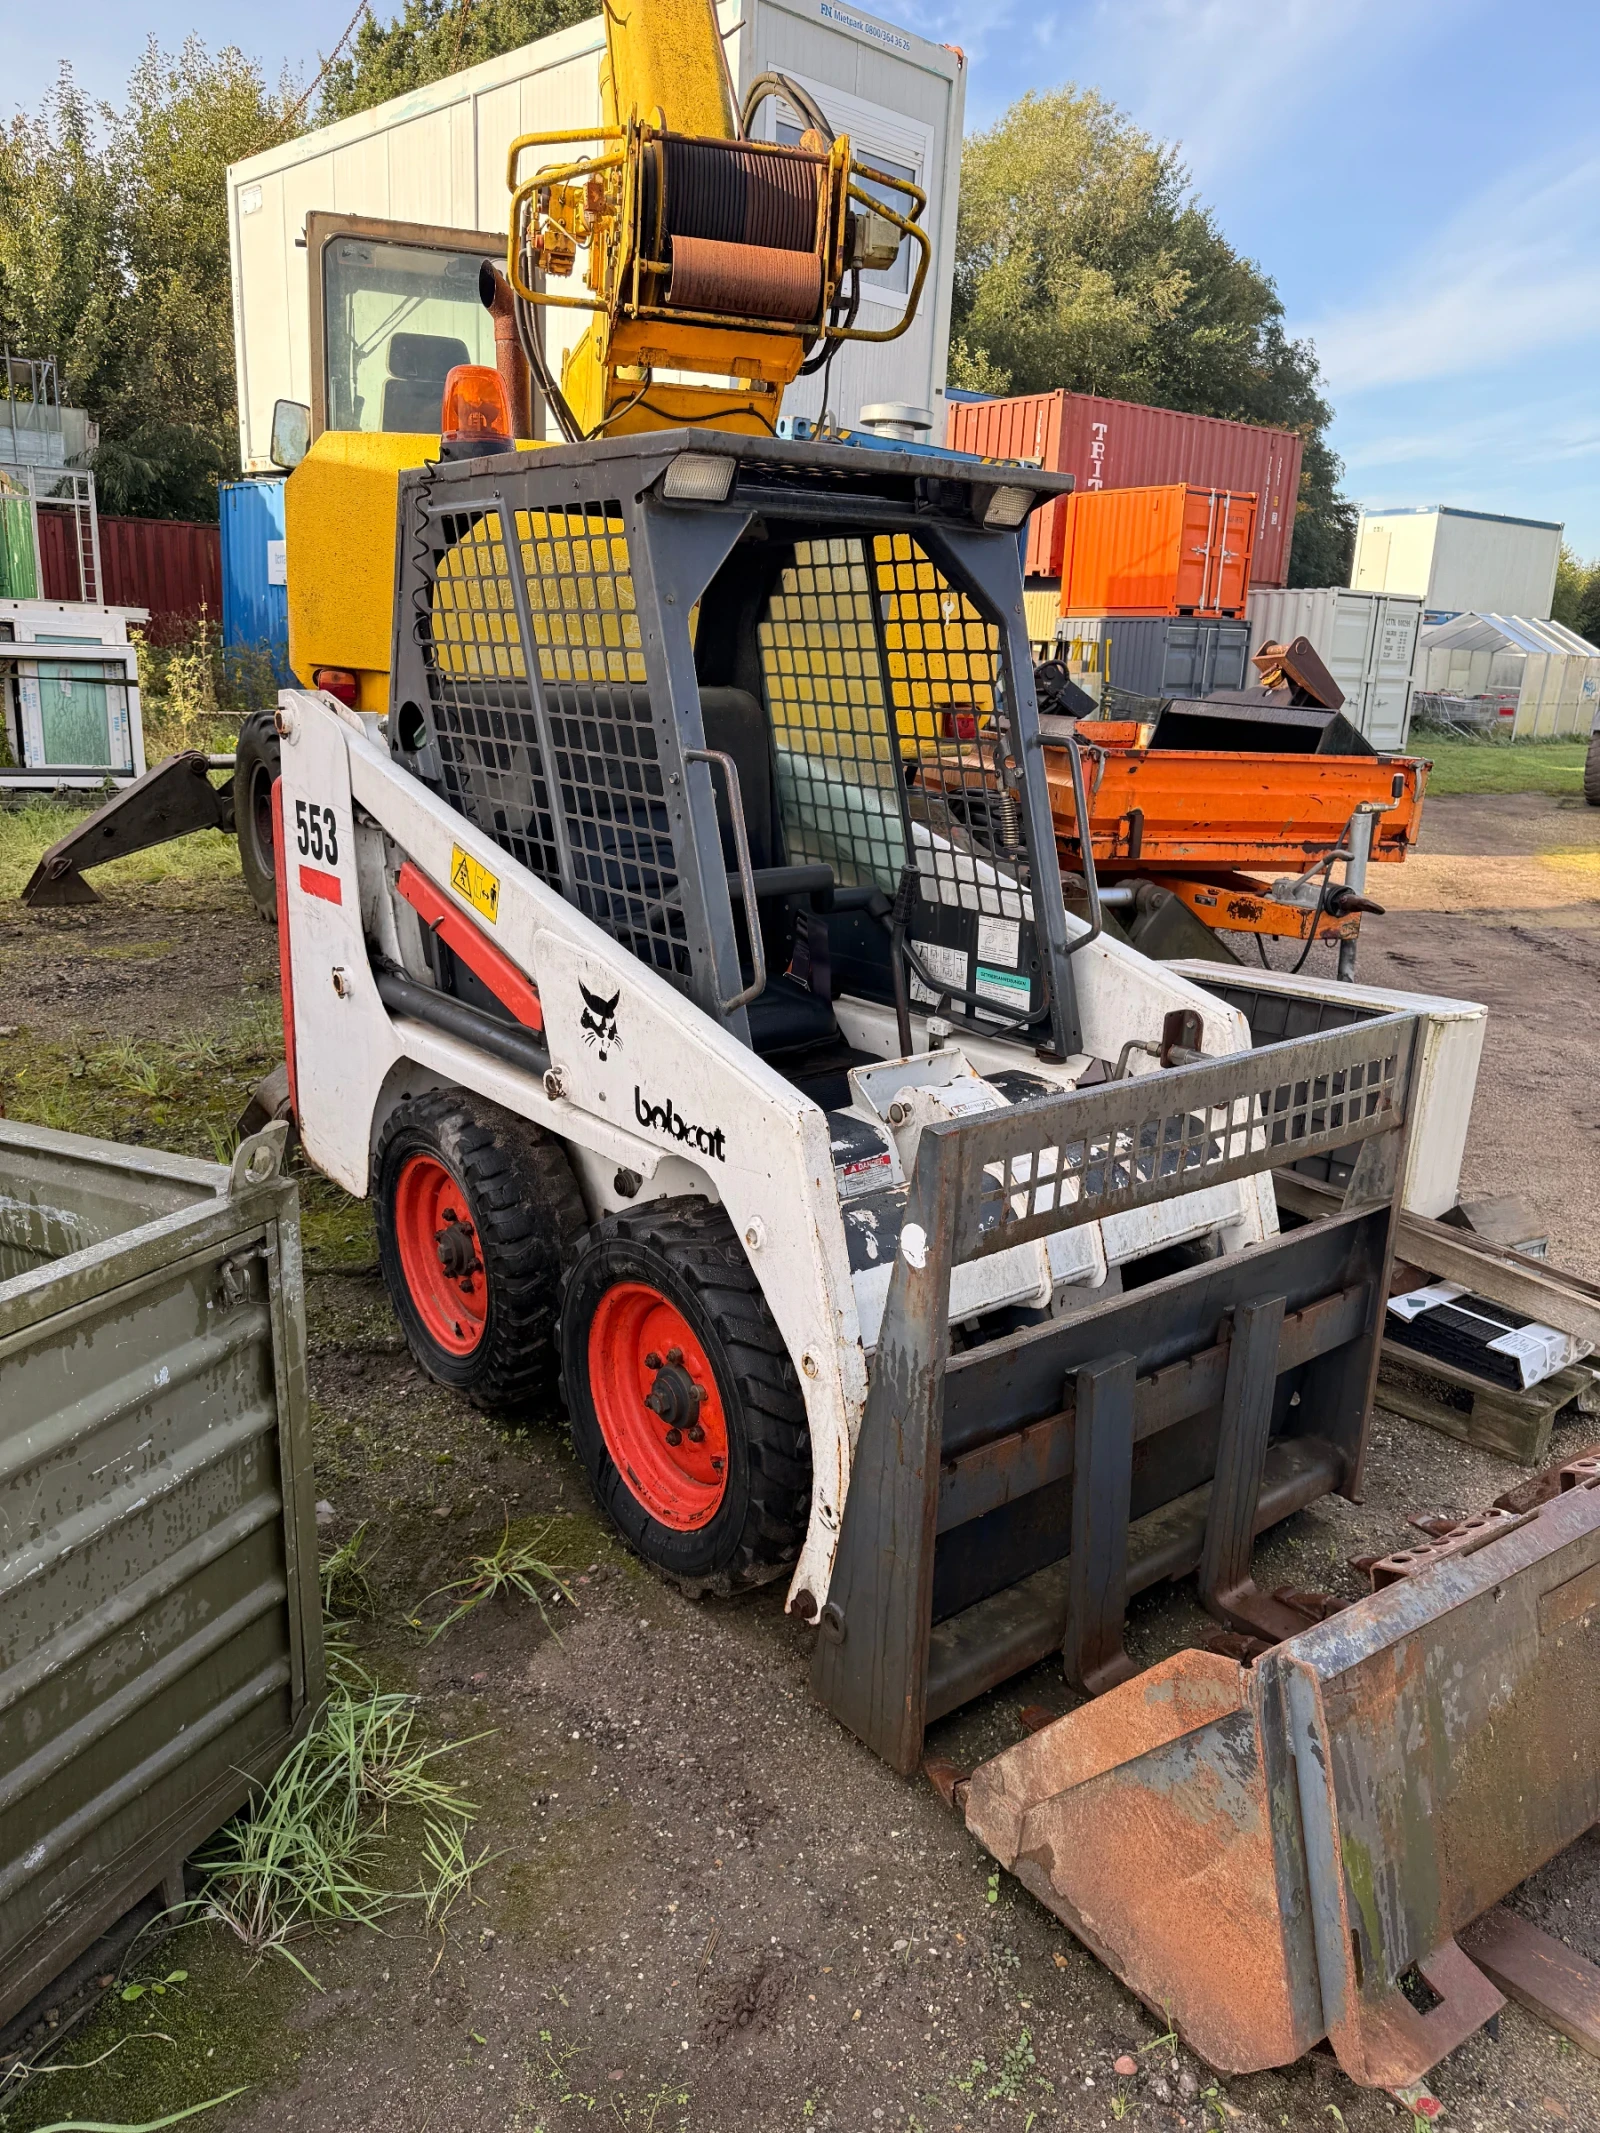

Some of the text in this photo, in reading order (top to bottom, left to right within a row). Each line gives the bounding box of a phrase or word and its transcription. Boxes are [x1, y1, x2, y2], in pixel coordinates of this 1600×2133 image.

[834, 10, 863, 31] Mietpark
[295, 799, 339, 866] 553
[634, 1085, 726, 1163] bobcat
